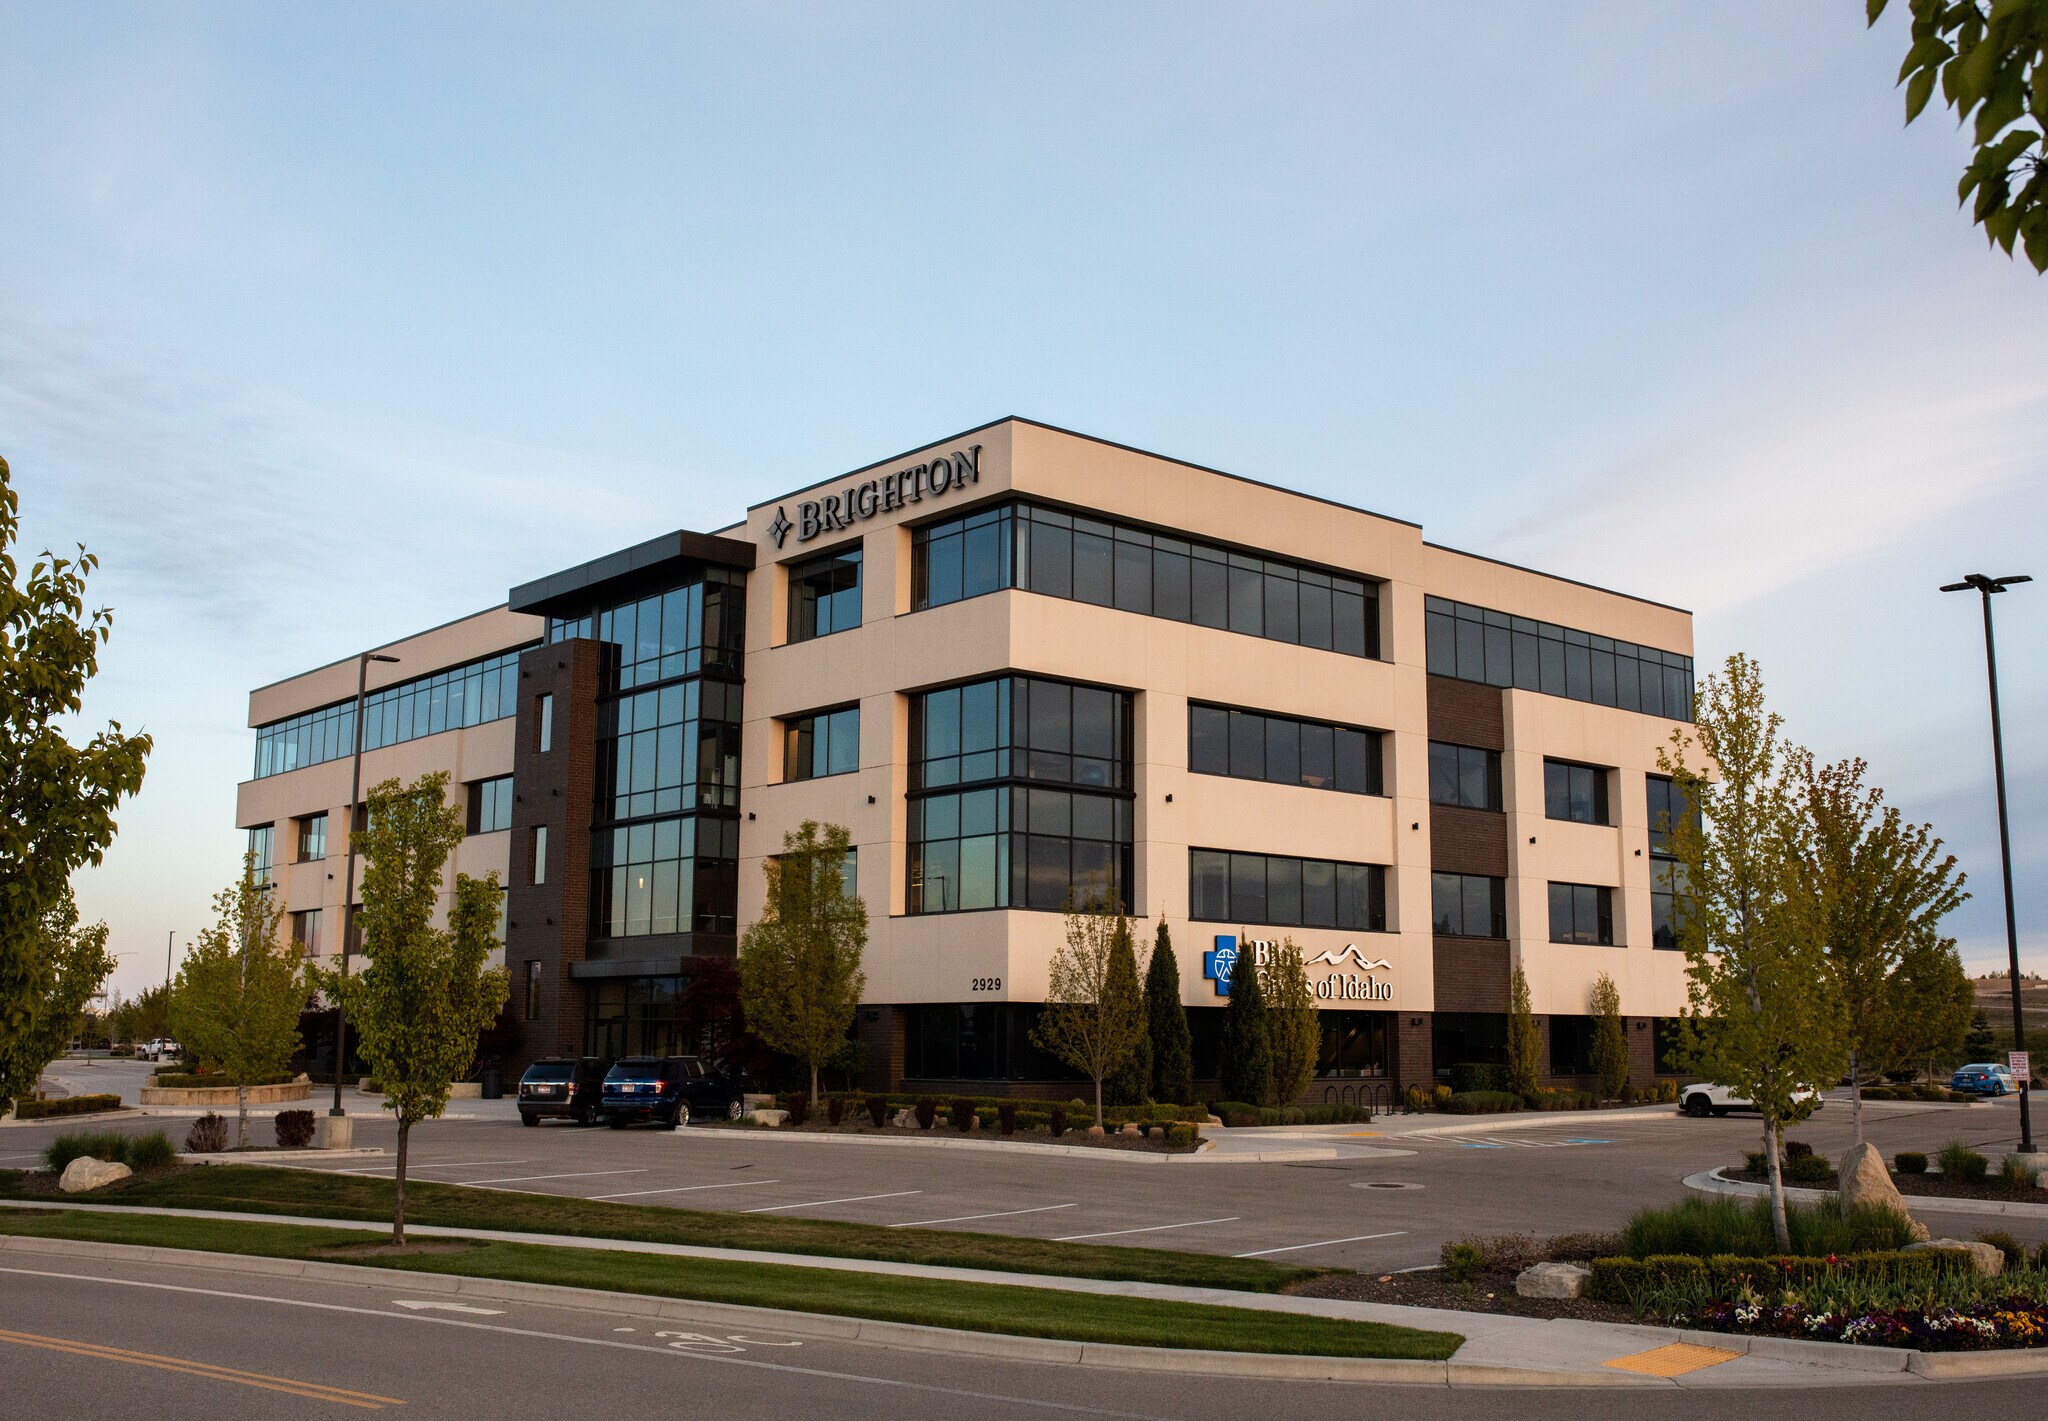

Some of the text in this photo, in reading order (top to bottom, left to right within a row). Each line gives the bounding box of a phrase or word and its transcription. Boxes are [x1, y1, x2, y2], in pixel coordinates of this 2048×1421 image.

[797, 444, 982, 542] BRIGHTON
[972, 977, 1002, 991] 2929
[1256, 970, 1393, 1000] Crs of Idaho
